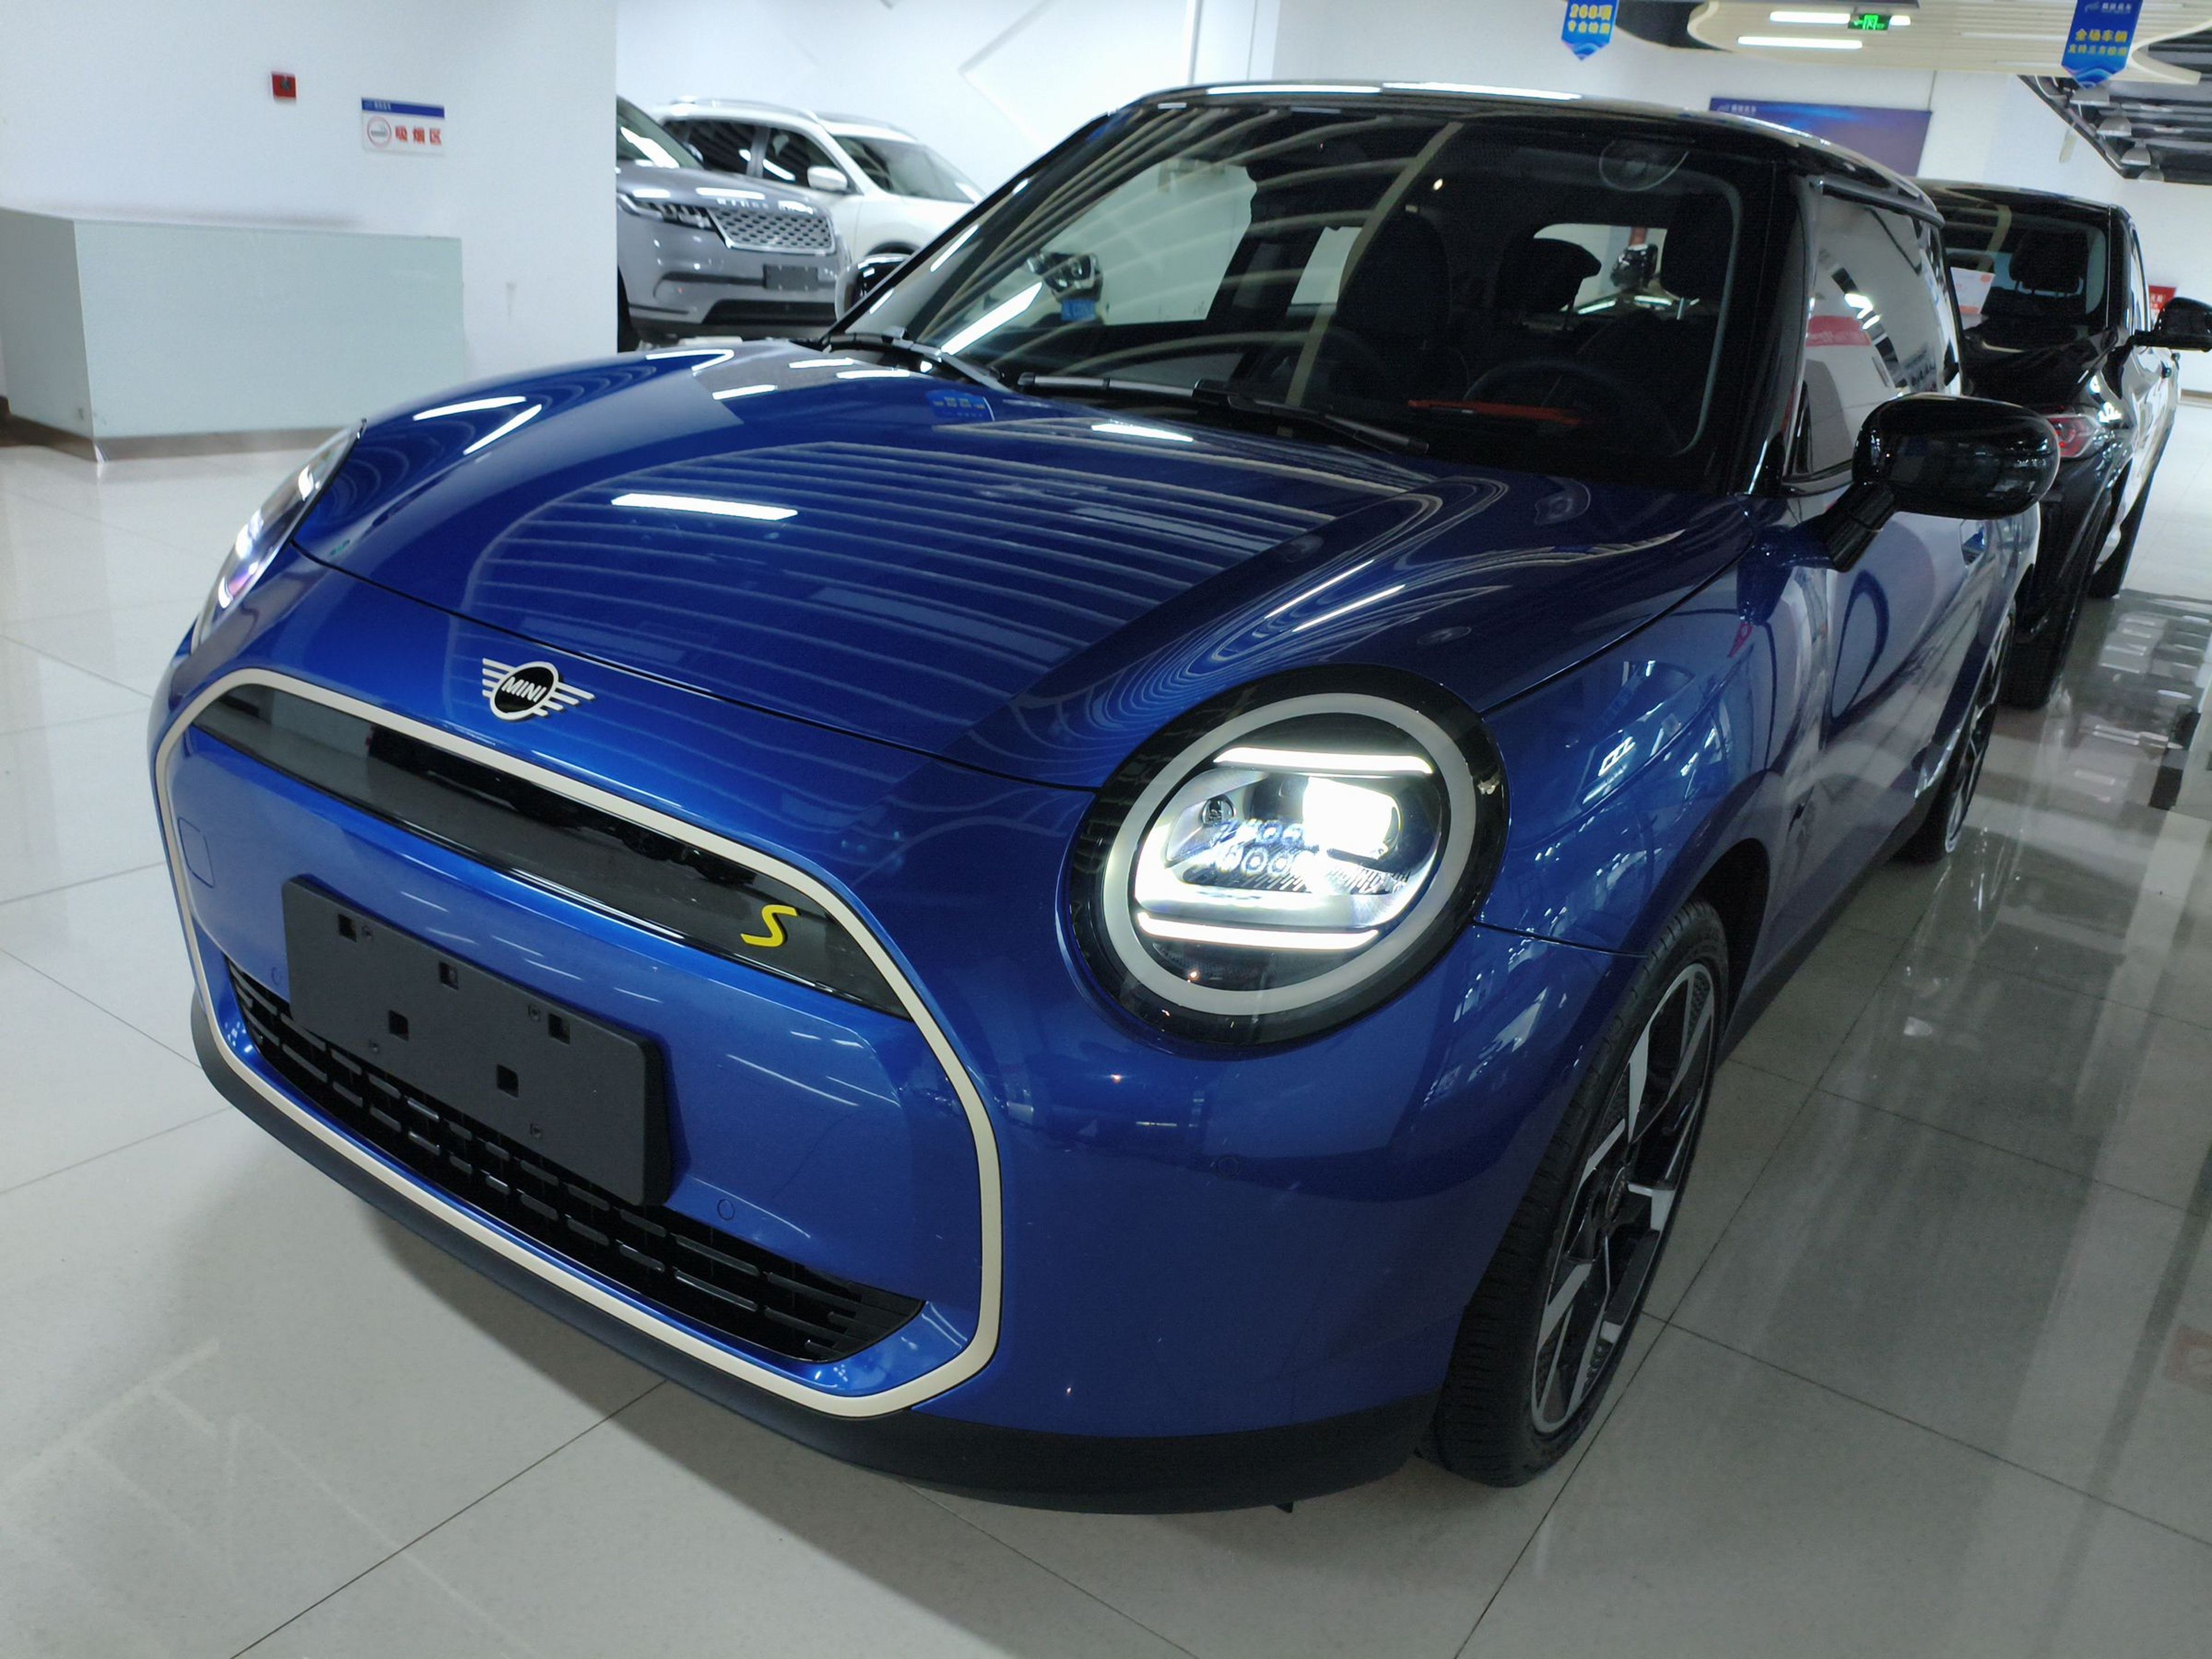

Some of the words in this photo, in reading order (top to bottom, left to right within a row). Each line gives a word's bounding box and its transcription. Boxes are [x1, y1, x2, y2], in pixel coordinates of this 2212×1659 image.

[395, 125, 442, 146] 吸烟区
[501, 676, 547, 703] MINI
[740, 904, 798, 947] S
